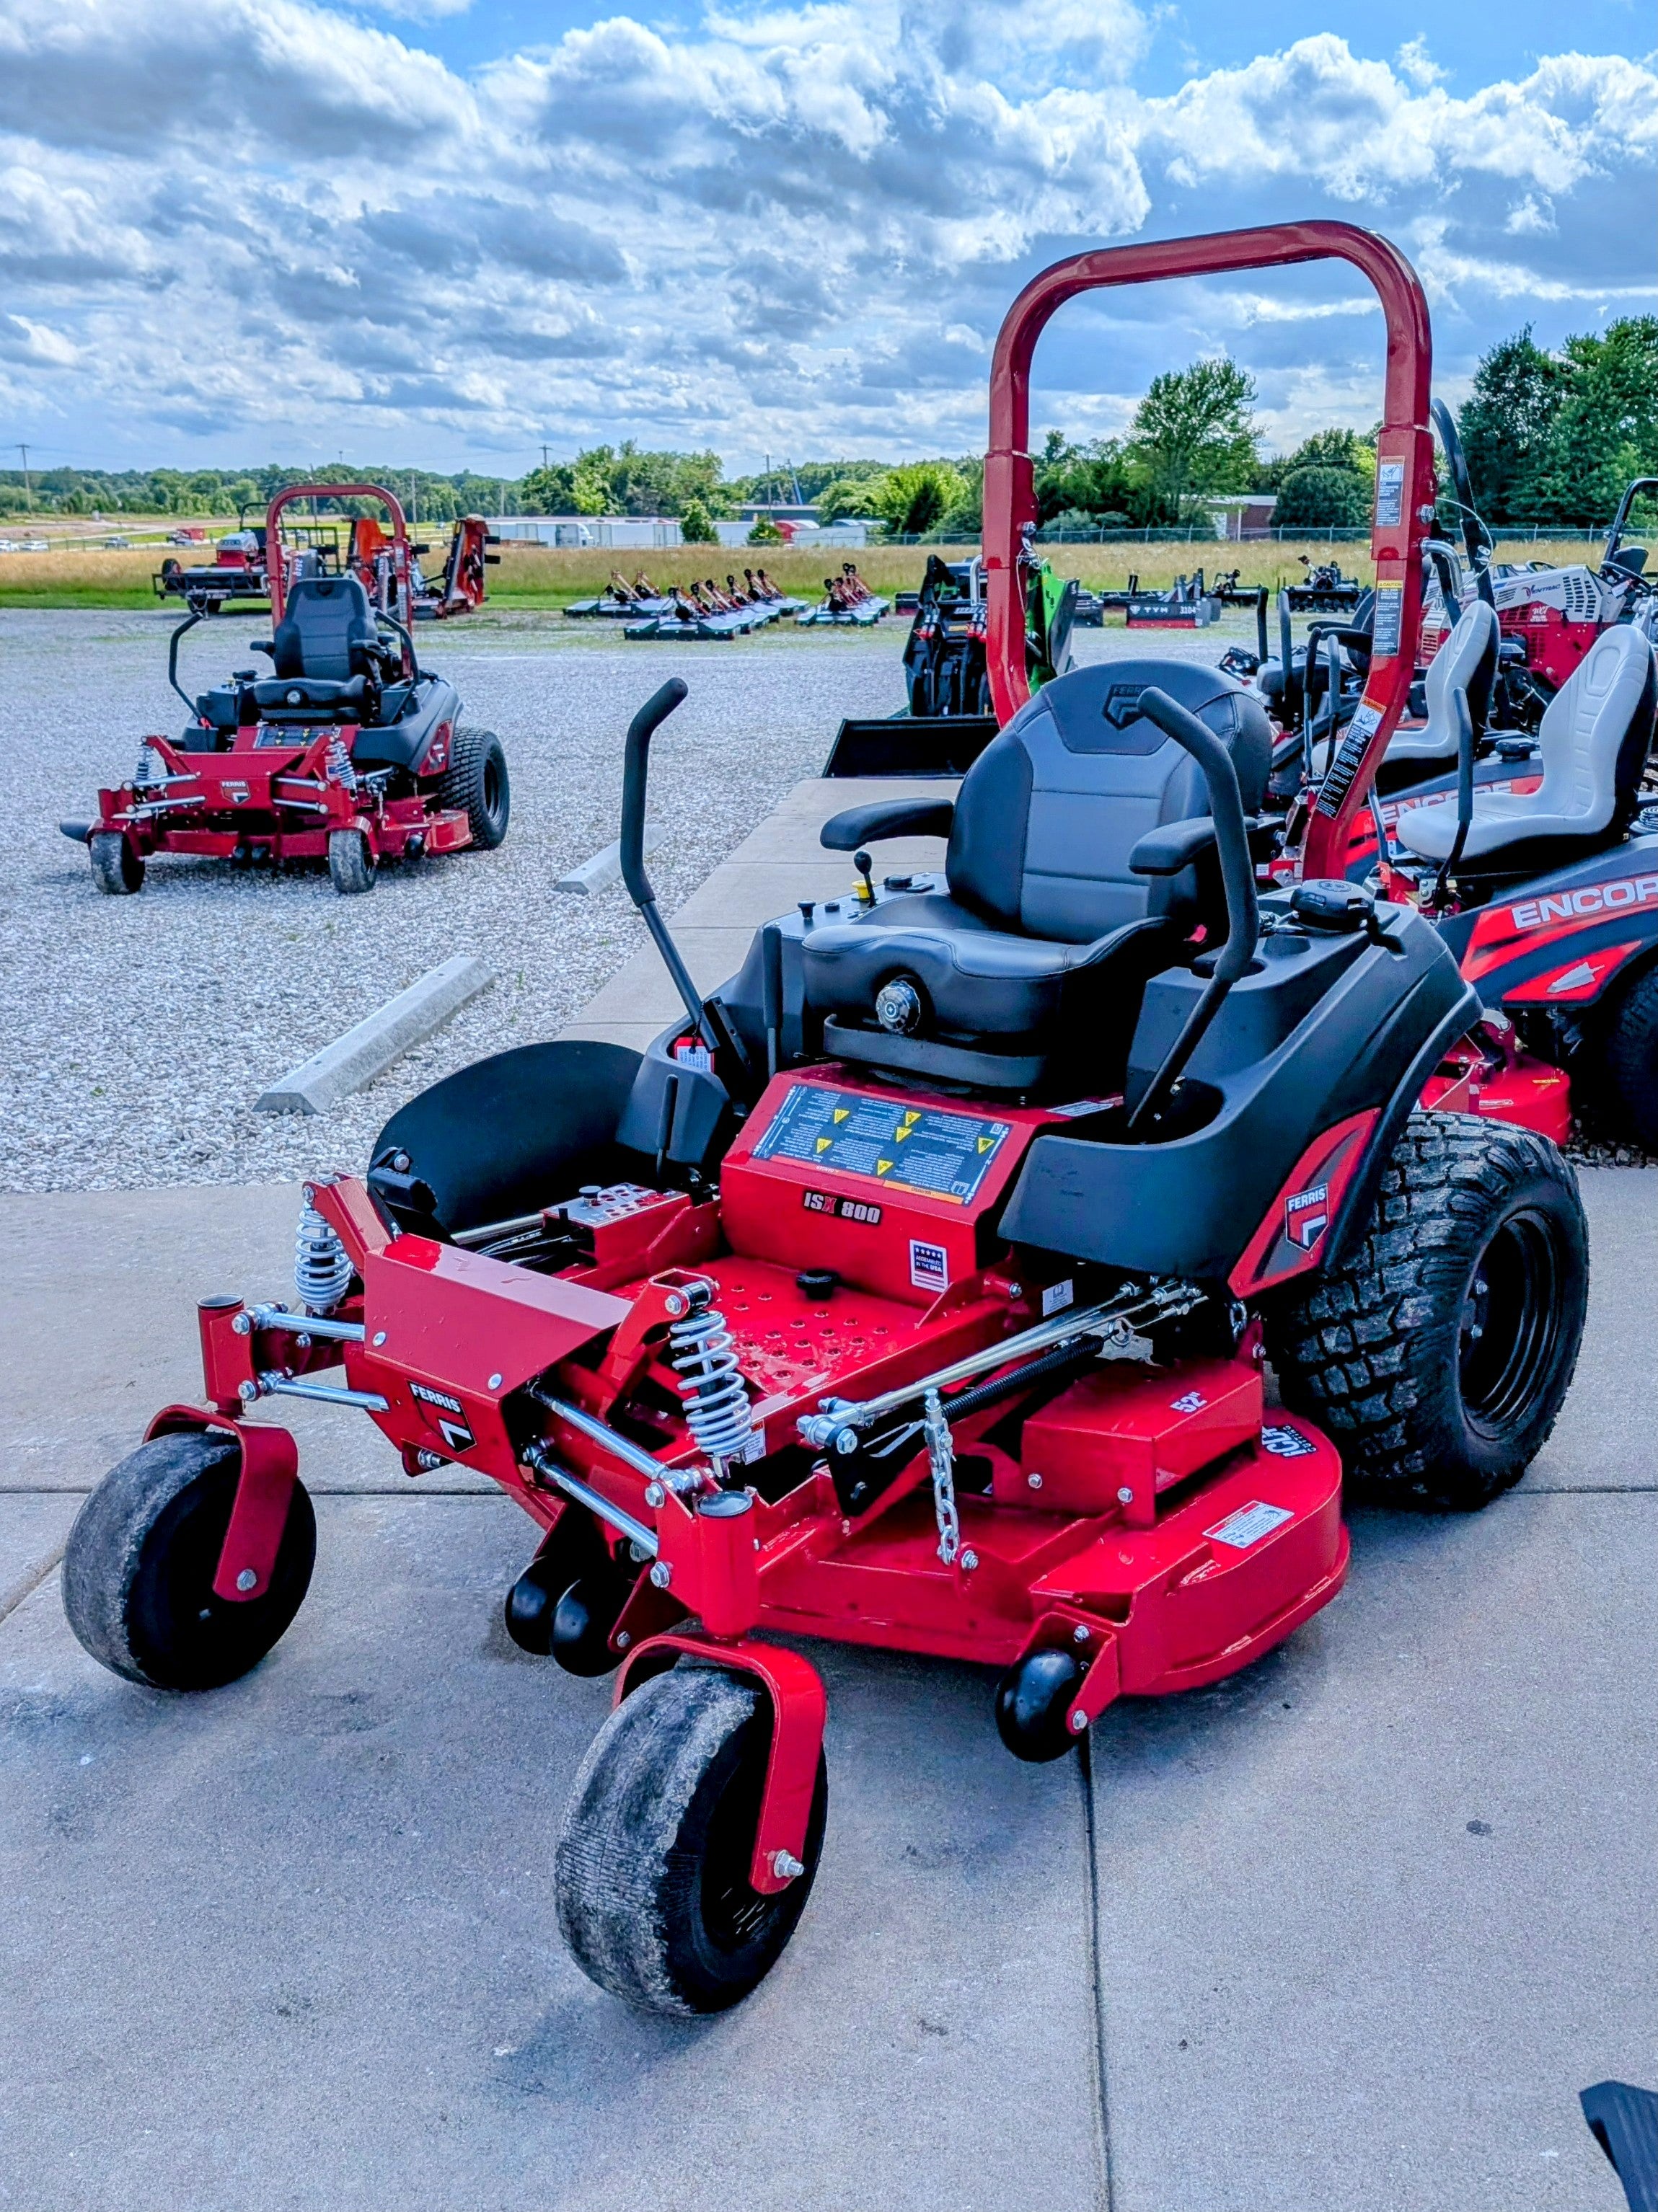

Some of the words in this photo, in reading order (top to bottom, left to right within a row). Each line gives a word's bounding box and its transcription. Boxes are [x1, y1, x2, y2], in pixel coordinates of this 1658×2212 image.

[804, 1192, 837, 1214] ISX
[841, 1201, 881, 1224] 800
[1288, 1187, 1326, 1212] FERRIS
[916, 1255, 942, 1266] ASSEMBLED
[930, 1264, 943, 1273] USA
[409, 1383, 461, 1413] FERRIS
[1282, 1425, 1317, 1453] CUTTING
